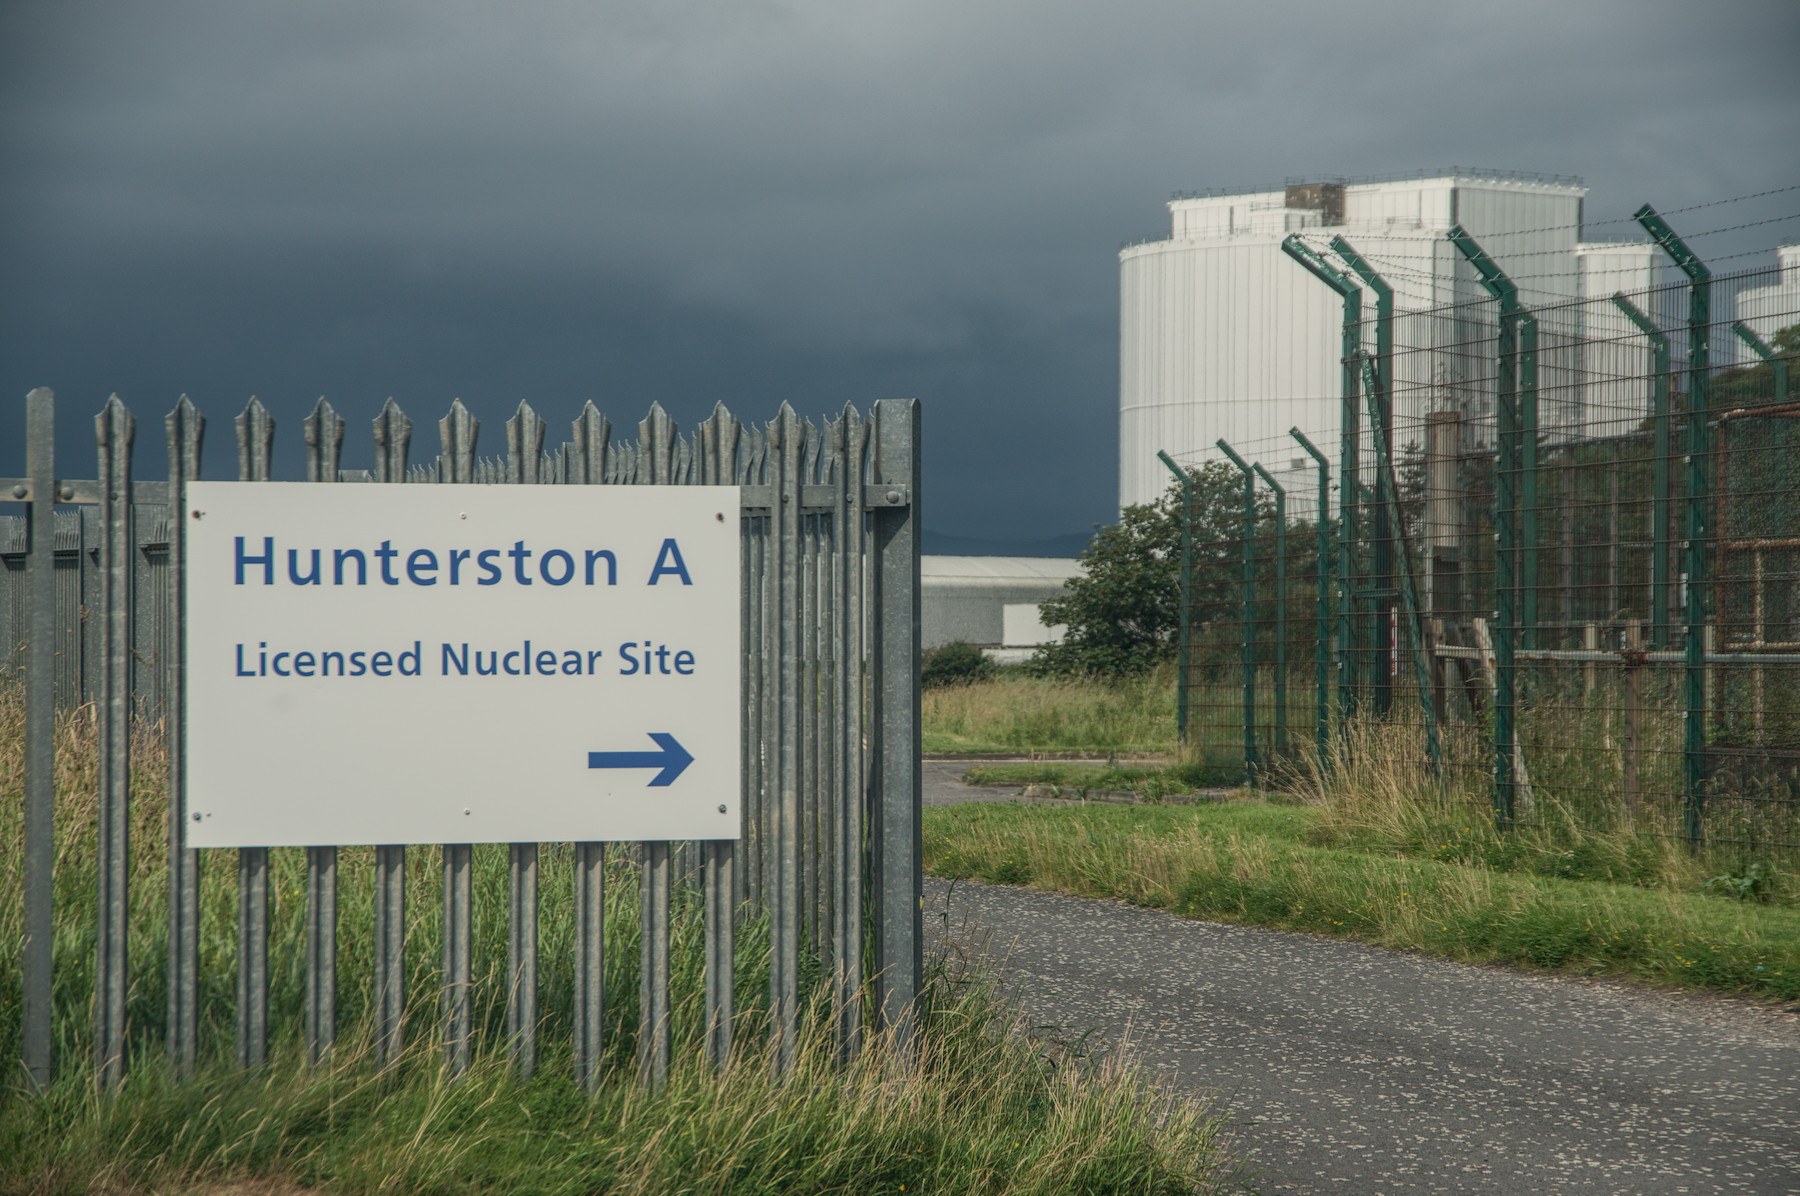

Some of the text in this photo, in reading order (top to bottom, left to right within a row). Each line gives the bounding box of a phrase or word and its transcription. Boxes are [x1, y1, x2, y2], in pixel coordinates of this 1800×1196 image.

[234, 535, 693, 587] Hunterston A
[236, 640, 695, 677] Licensed Nuclear Site
